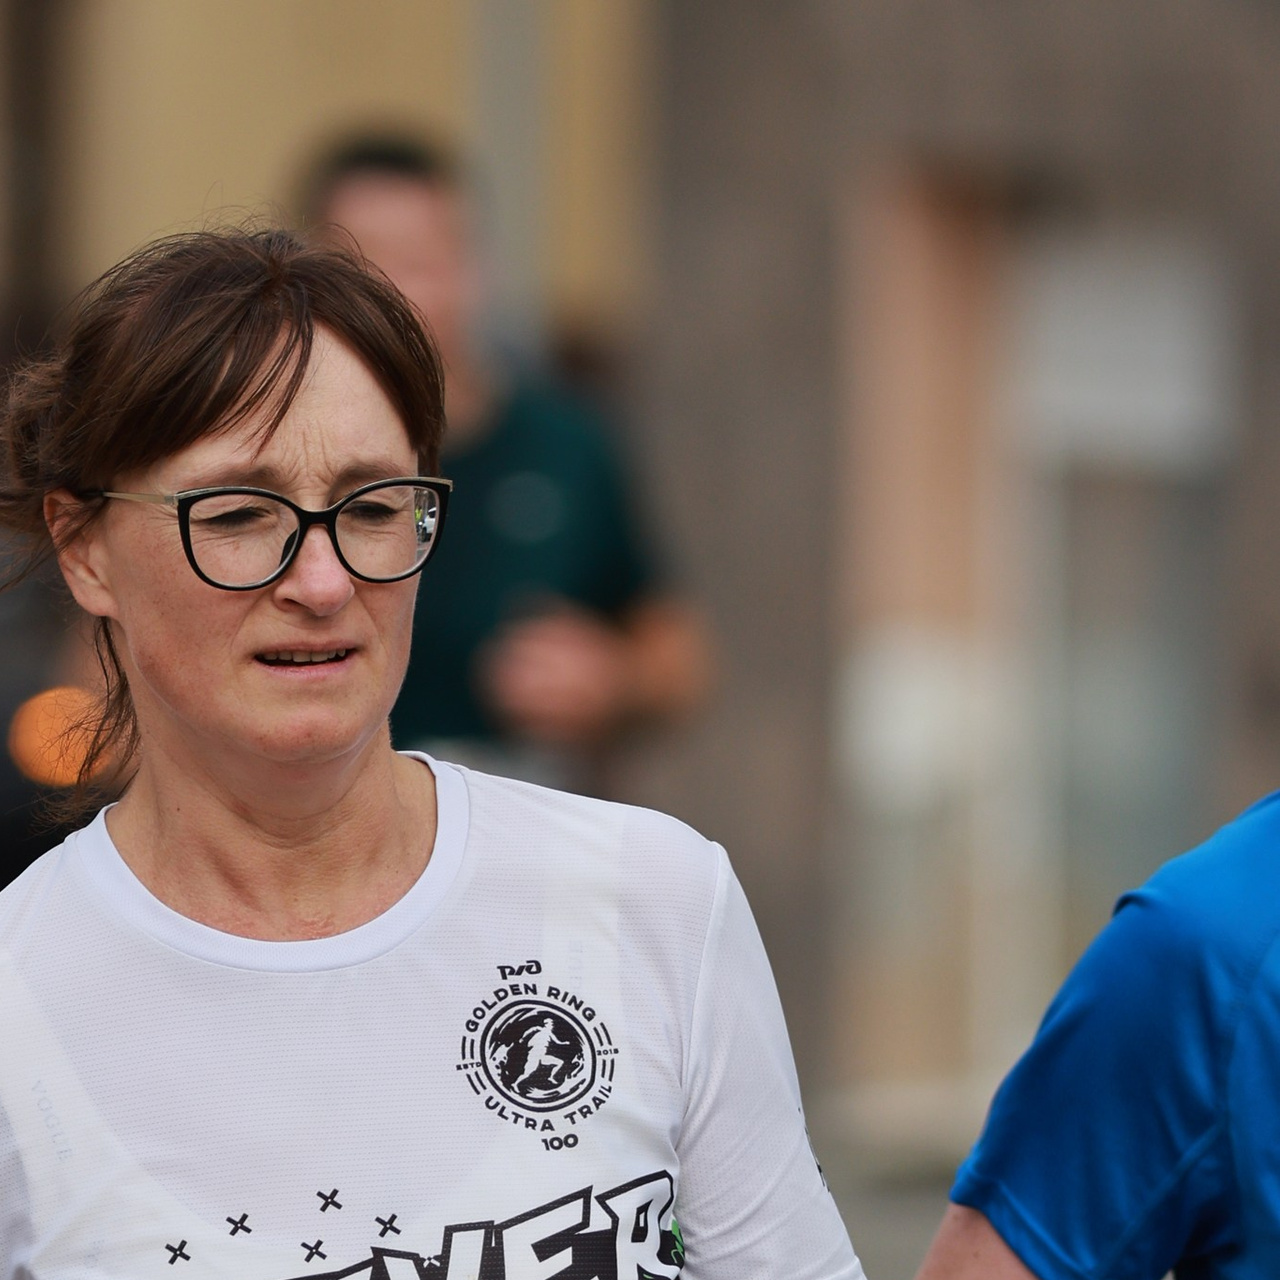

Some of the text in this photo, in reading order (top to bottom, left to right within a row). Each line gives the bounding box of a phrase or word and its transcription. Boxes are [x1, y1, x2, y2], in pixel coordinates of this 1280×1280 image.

[465, 983, 596, 1033] GOLDEN RING
[485, 1085, 612, 1131] ULTRA TRAIL
[541, 1133, 579, 1151] 100
